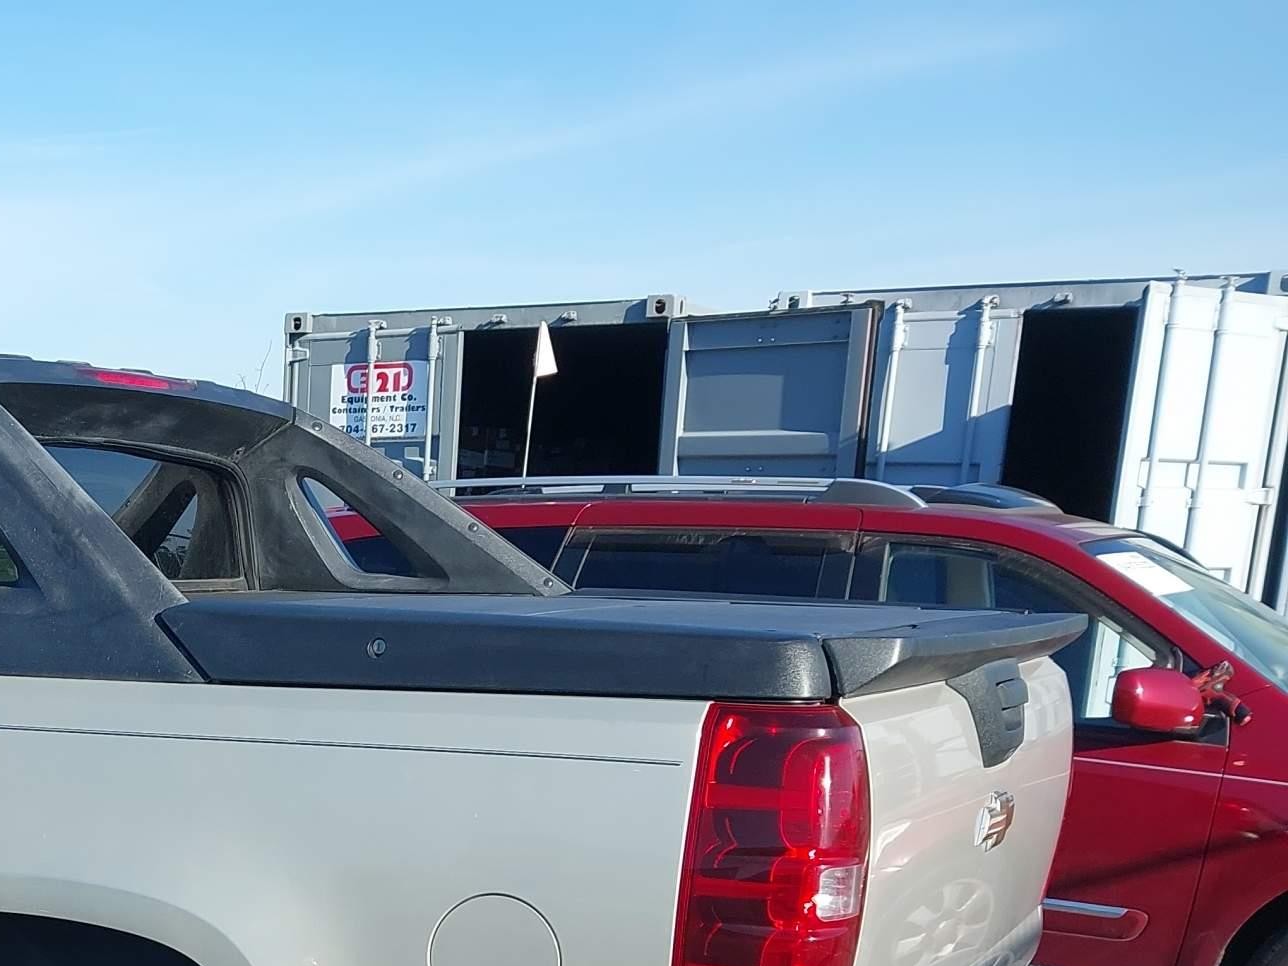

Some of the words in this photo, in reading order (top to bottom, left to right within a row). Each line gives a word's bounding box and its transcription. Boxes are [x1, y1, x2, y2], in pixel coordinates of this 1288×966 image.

[400, 393, 417, 402] Co.
[332, 406, 381, 415] Containrs
[389, 404, 426, 413] Trailers
